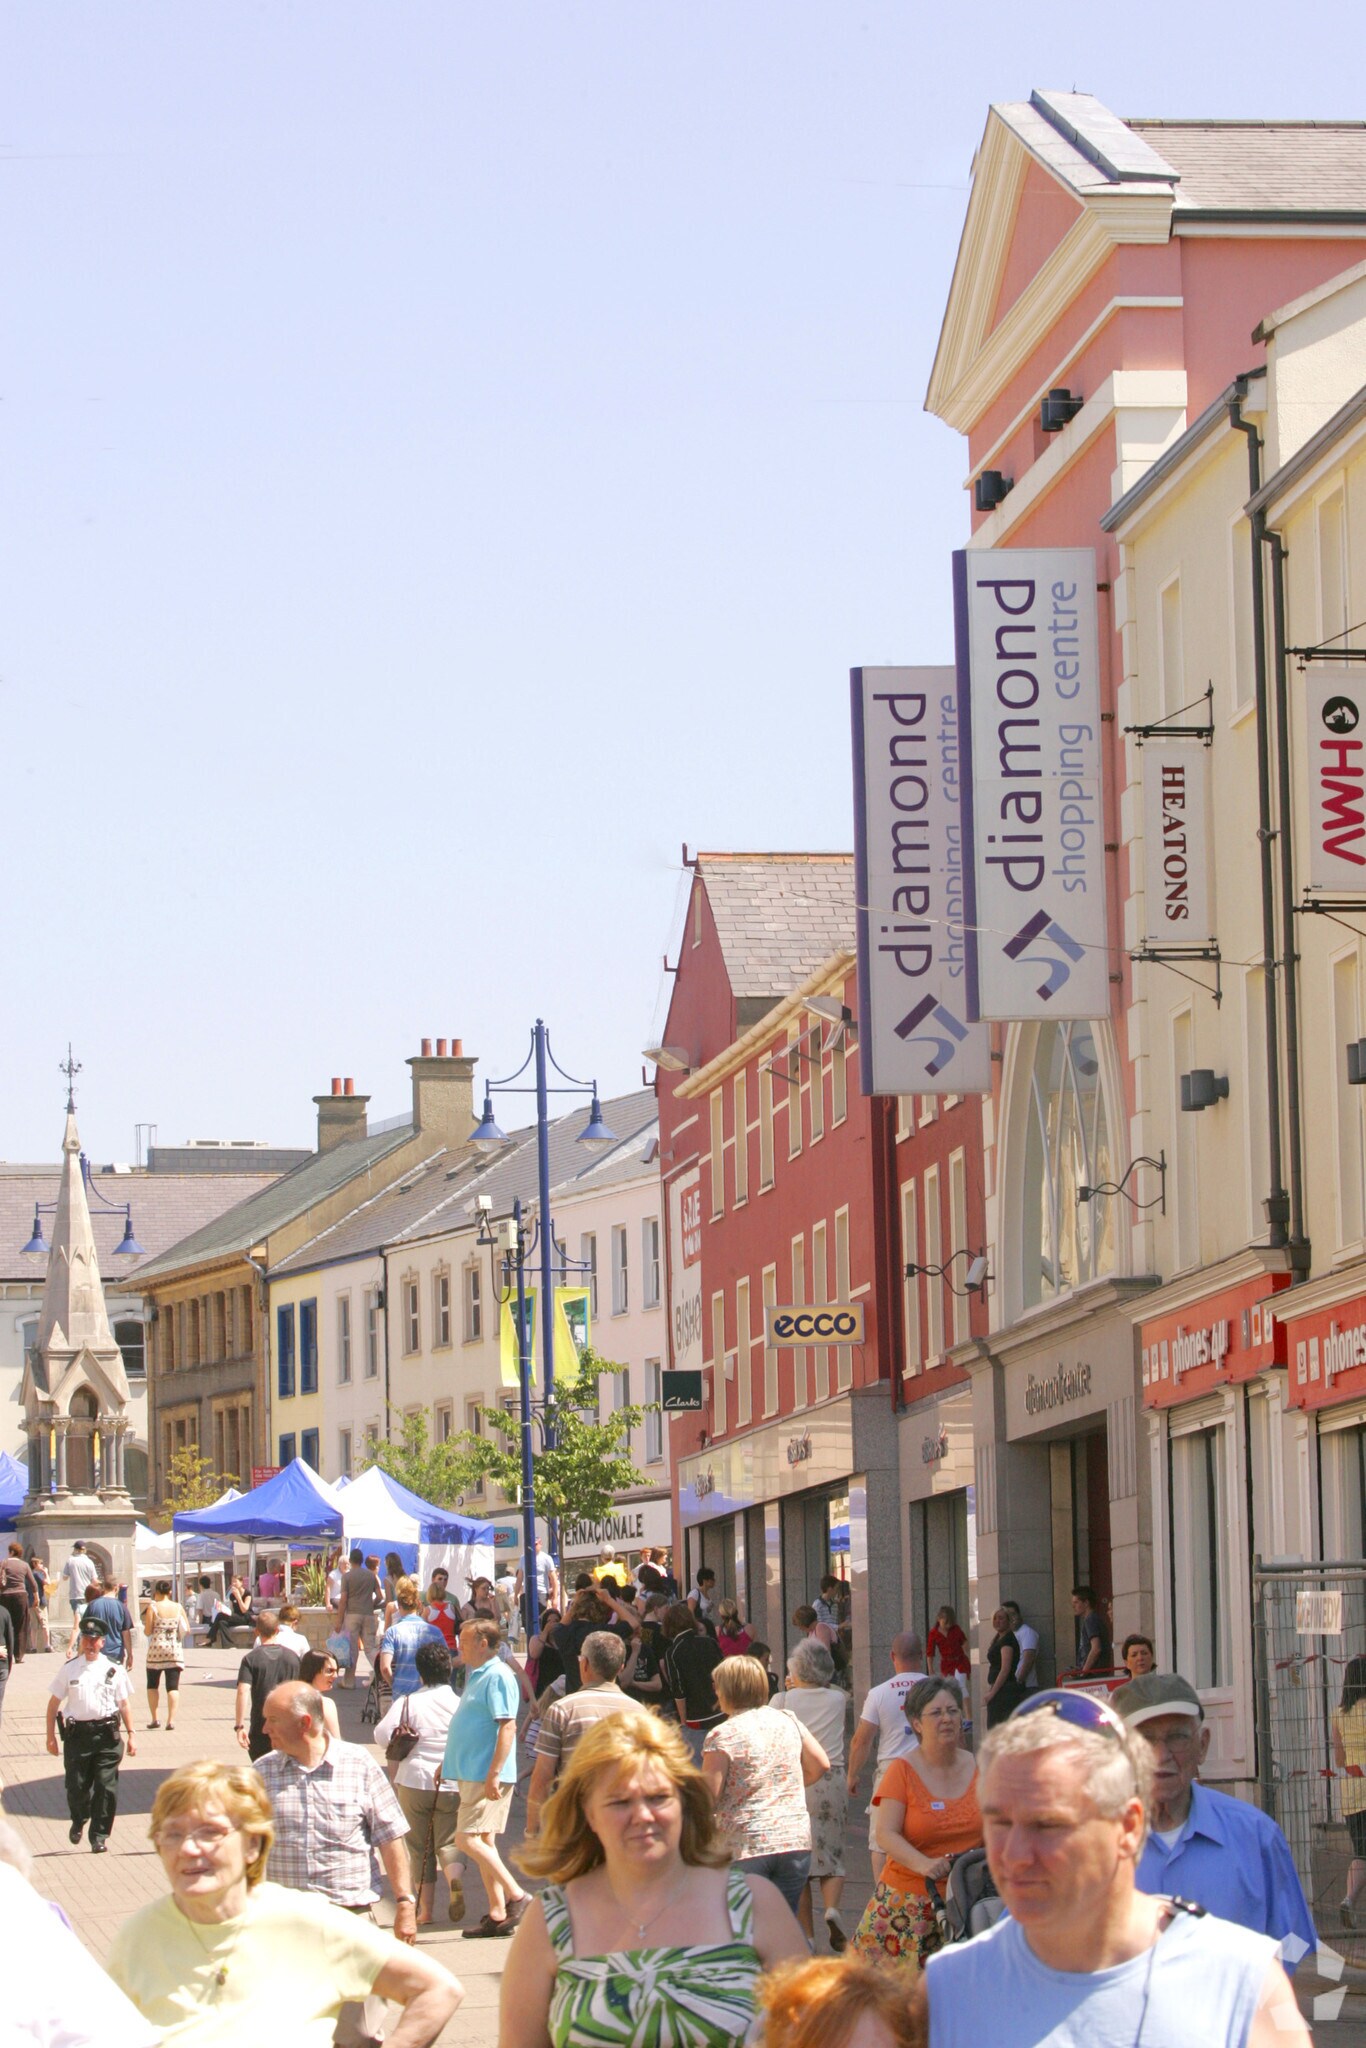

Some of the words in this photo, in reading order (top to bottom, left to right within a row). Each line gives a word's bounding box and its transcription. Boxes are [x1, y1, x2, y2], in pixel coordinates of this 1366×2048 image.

[1048, 580, 1081, 700] centre
[937, 694, 960, 803] centre
[977, 579, 1045, 892] diamond
[873, 693, 933, 978] diamond
[1051, 724, 1095, 893] shopping
[1161, 764, 1189, 921] HEATONS
[1320, 739, 1366, 866] HMV
[773, 1312, 857, 1339] ecco
[1172, 1324, 1210, 1386] phones
[1324, 1320, 1366, 1389] phones
[665, 1396, 700, 1407] Clarks
[889, 1680, 916, 1689] HON
